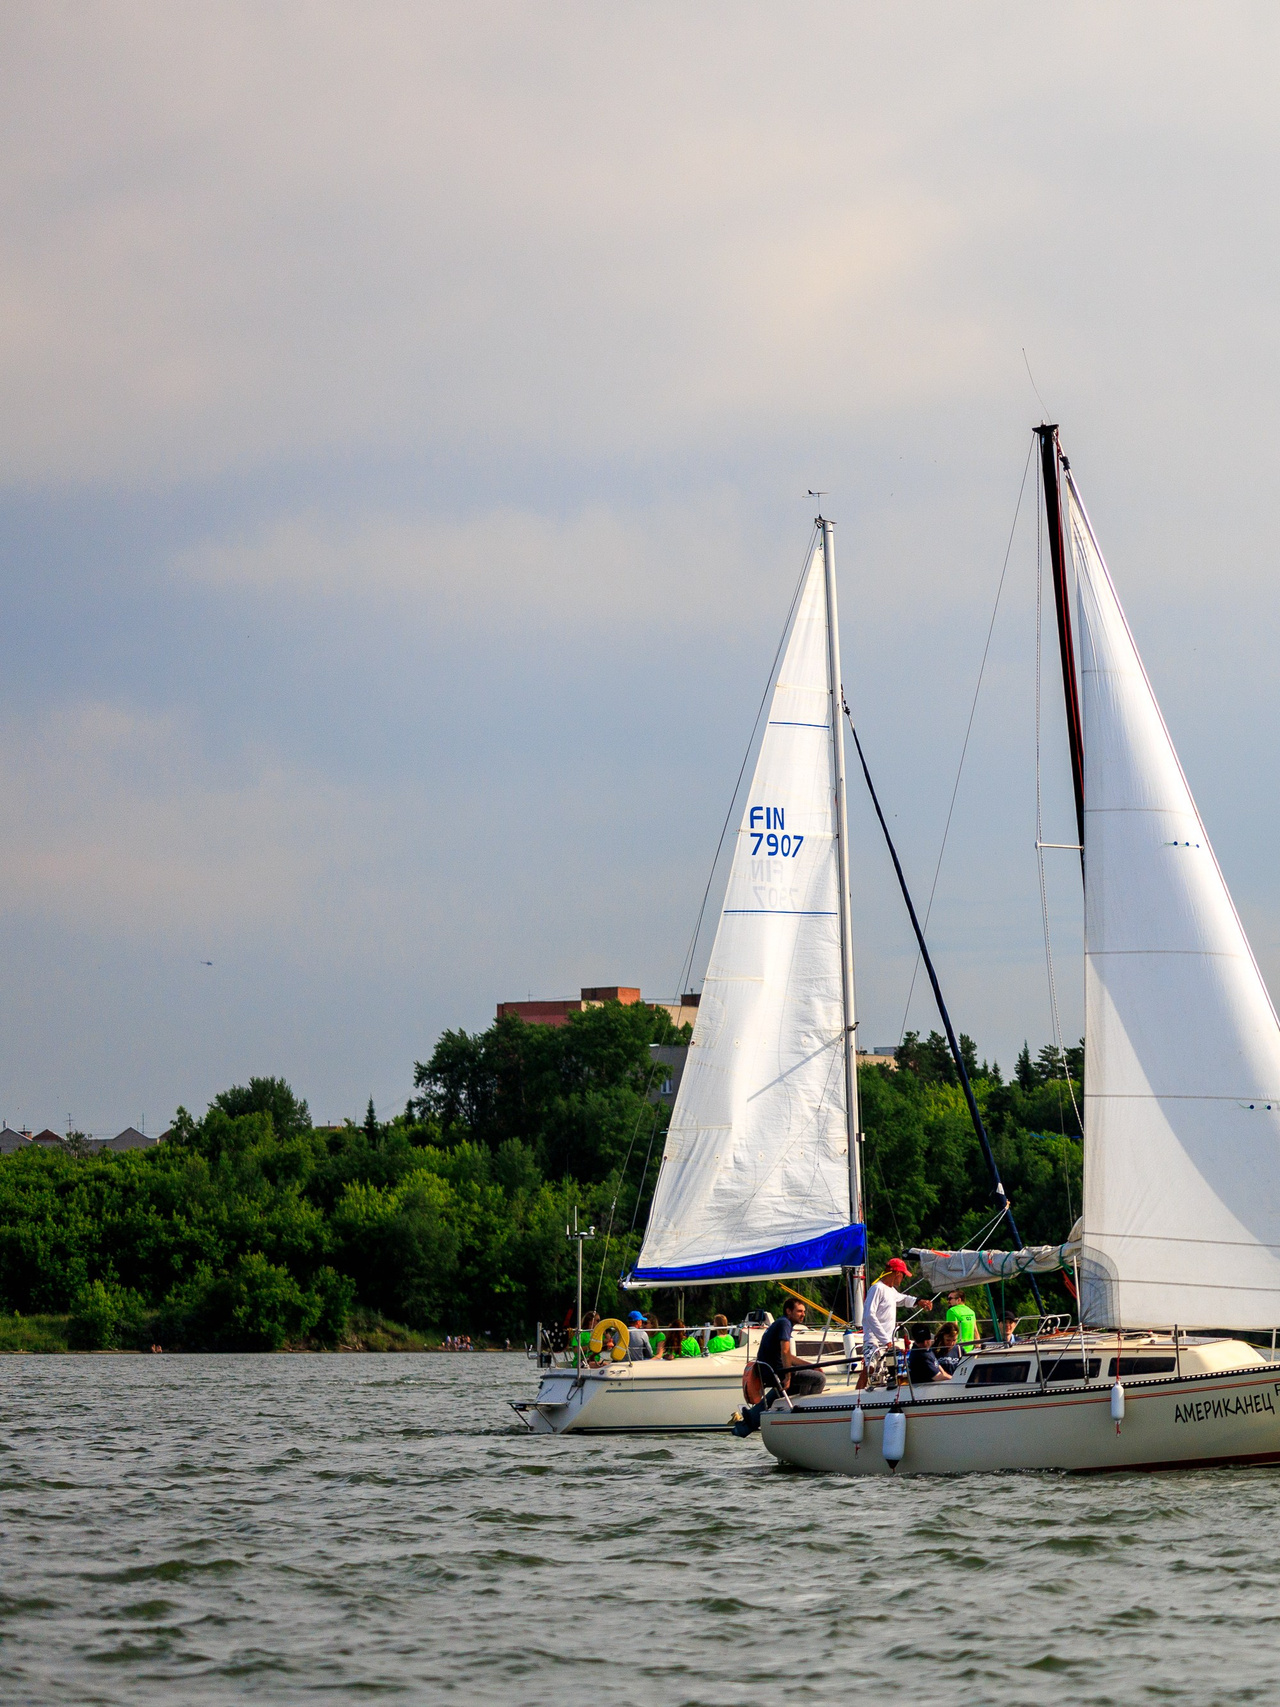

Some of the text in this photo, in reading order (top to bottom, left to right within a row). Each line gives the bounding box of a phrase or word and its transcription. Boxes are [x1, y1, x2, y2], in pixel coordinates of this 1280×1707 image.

[749, 806, 785, 830] FIN
[749, 832, 804, 858] 7907
[1174, 1392, 1276, 1424] АМЕРИКАНЕЦ
